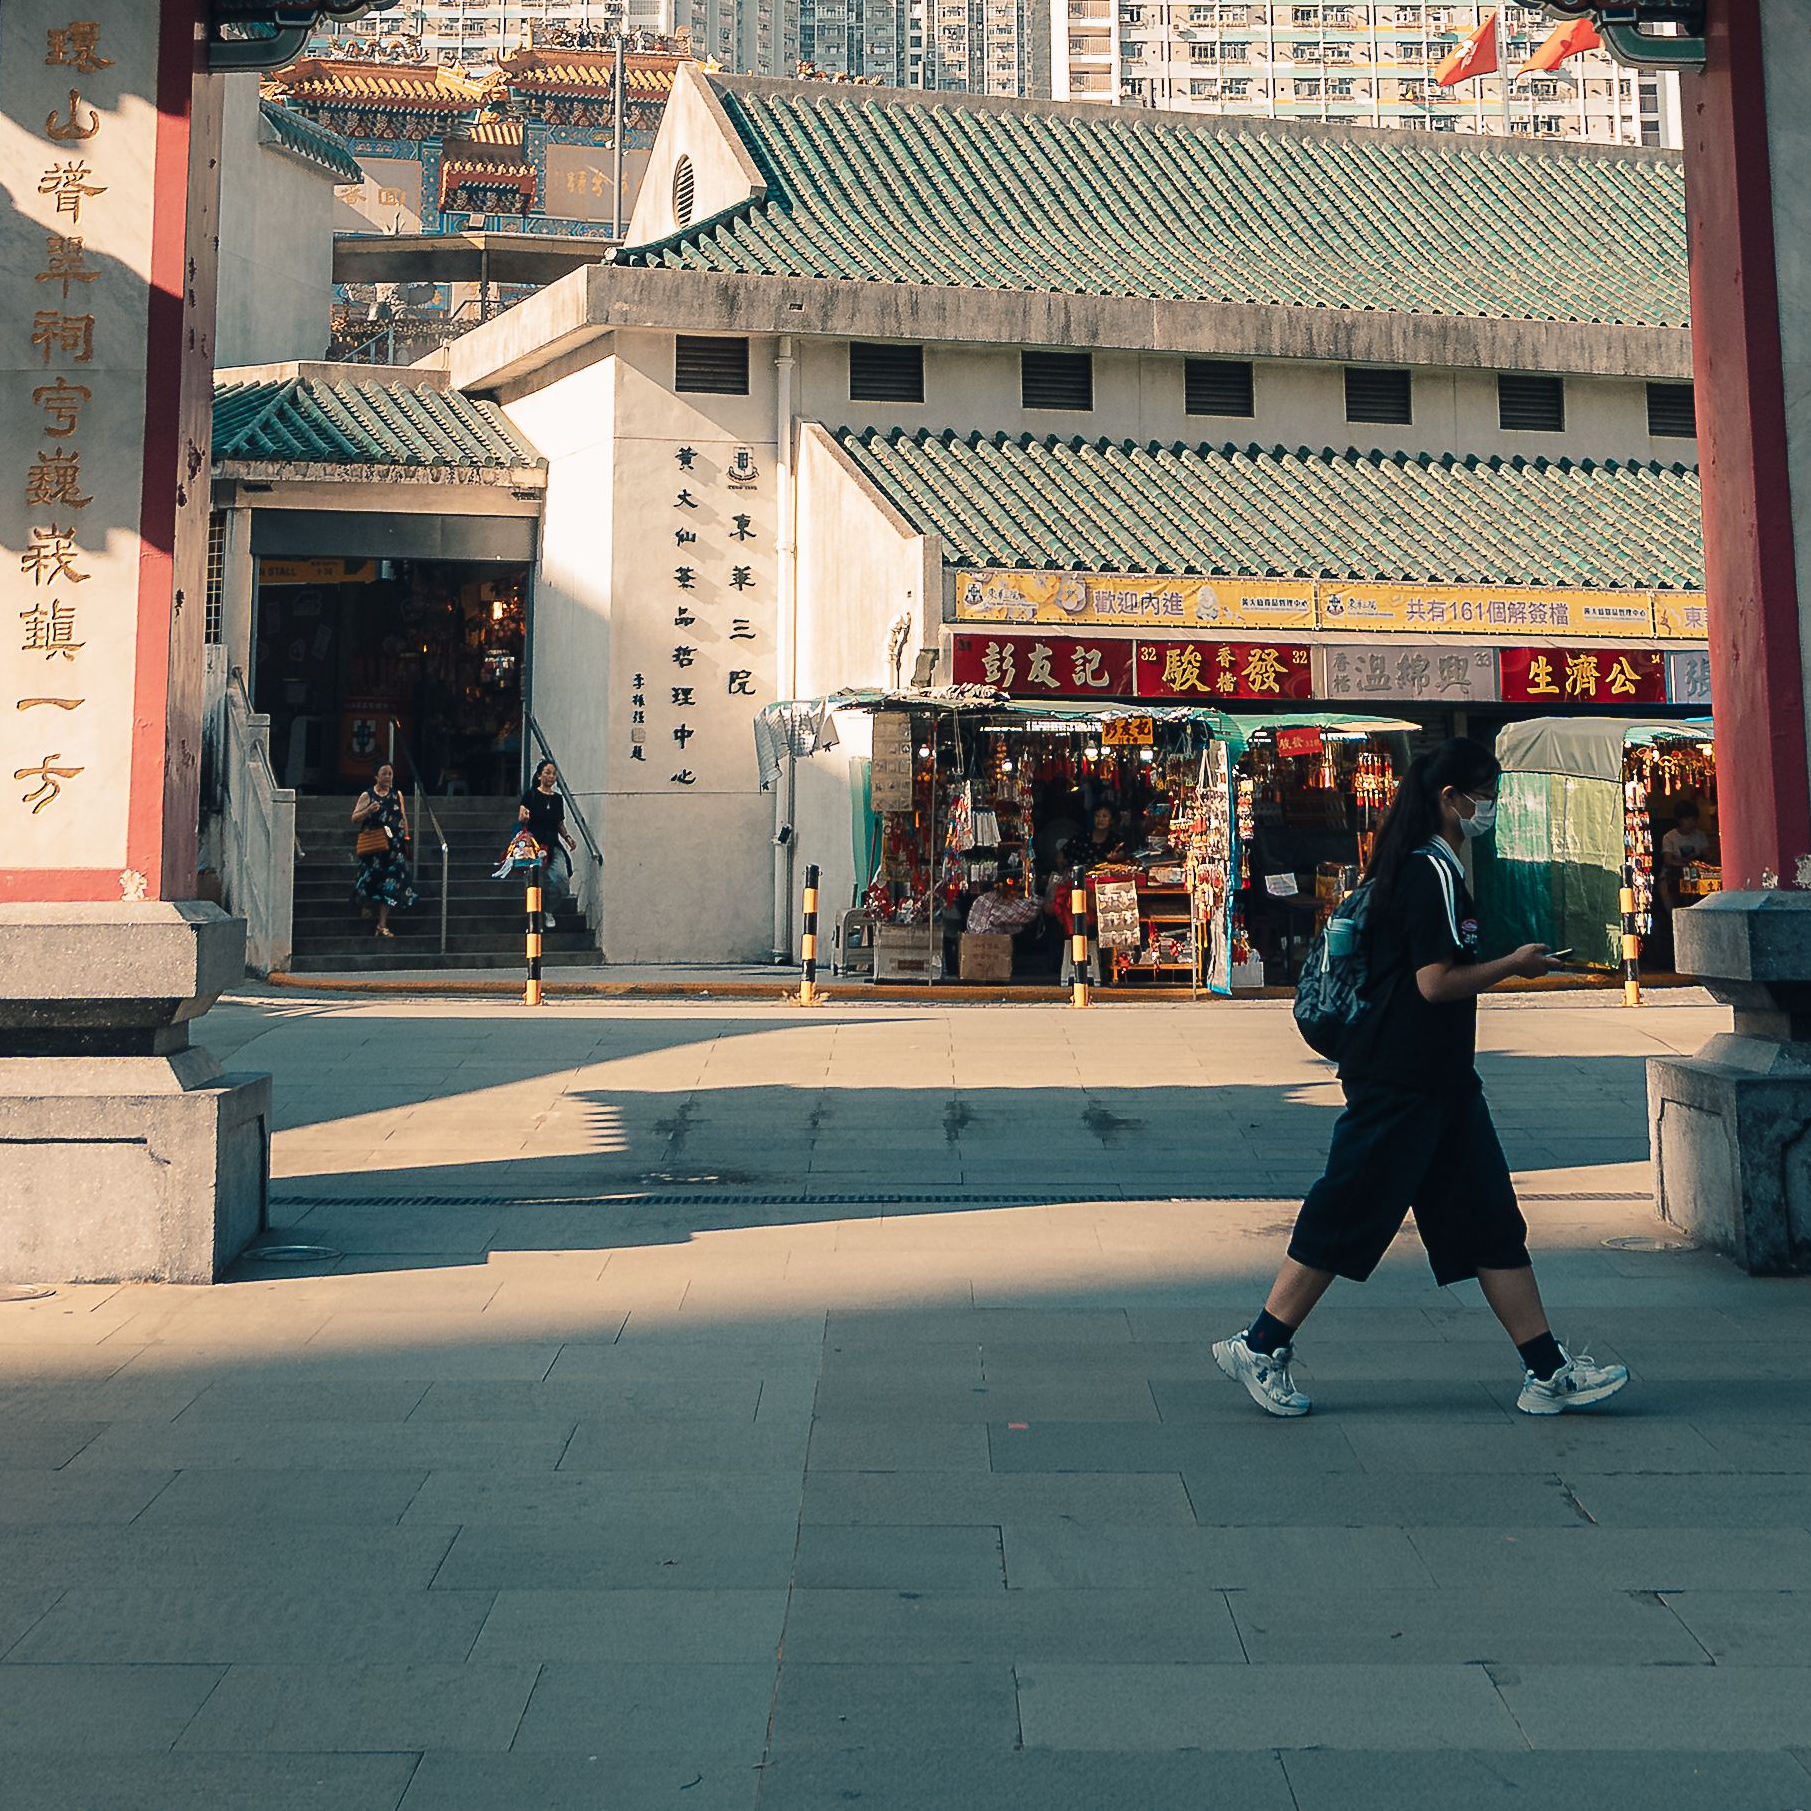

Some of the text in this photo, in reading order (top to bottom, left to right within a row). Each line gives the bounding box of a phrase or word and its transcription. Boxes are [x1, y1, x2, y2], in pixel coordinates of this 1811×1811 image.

[728, 513, 757, 695] 東華三院
[981, 641, 1110, 688] 彭友記
[1140, 646, 1157, 661] 32
[1292, 650, 1308, 664] 32
